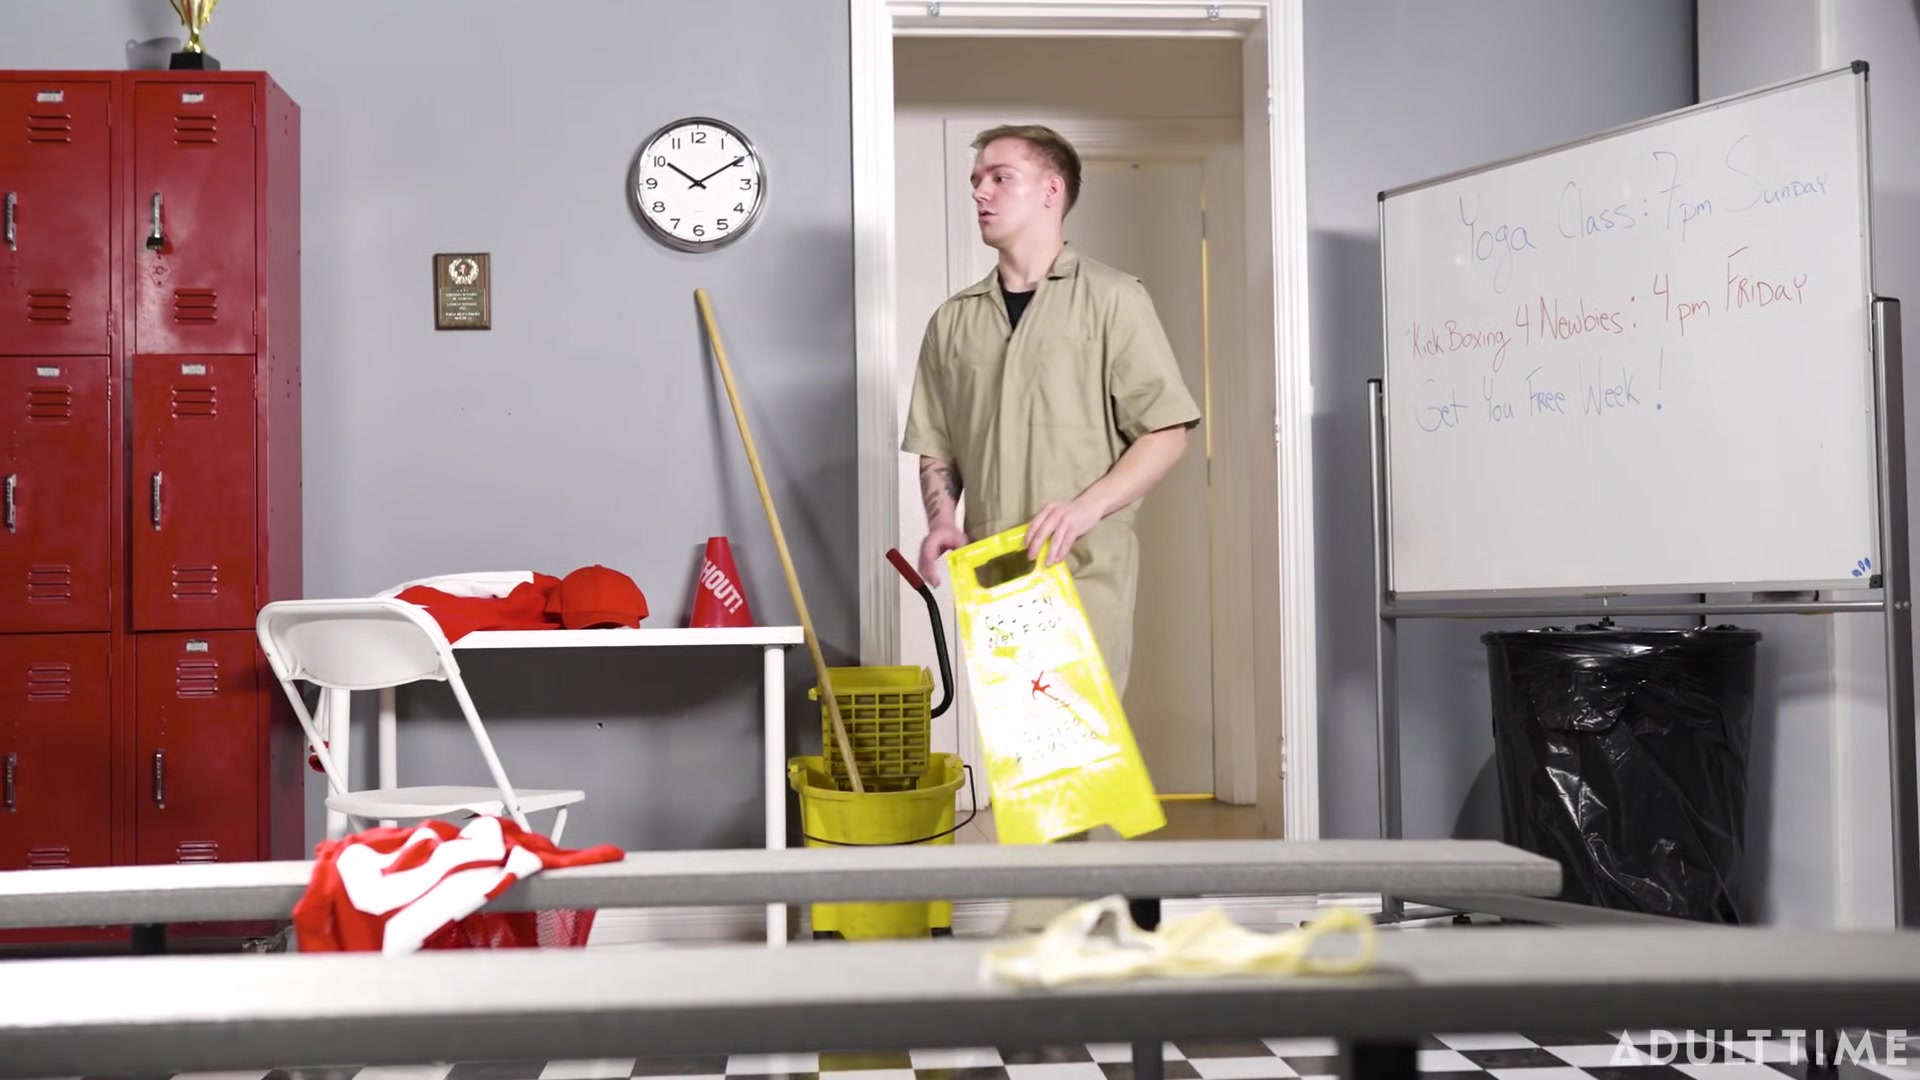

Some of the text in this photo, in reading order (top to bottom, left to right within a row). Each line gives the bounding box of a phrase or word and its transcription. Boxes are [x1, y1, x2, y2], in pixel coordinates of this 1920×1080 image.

[671, 137, 681, 150] 11
[690, 131, 707, 145] 12
[720, 138, 725, 150] 1
[653, 155, 667, 168] 10
[733, 155, 745, 167] 2
[645, 177, 658, 190] 9
[739, 178, 752, 191] 3
[652, 201, 666, 213] 8
[733, 202, 745, 214] 4
[669, 218, 681, 230] 7
[692, 224, 705, 237] 6
[716, 218, 729, 231] 5
[1459, 192, 1537, 294] Yoga
[1557, 180, 1649, 239] Class:
[1515, 303, 1530, 346] 4
[1416, 378, 1469, 432] Get
[1482, 375, 1515, 422] You
[700, 556, 744, 615] HOUT!
